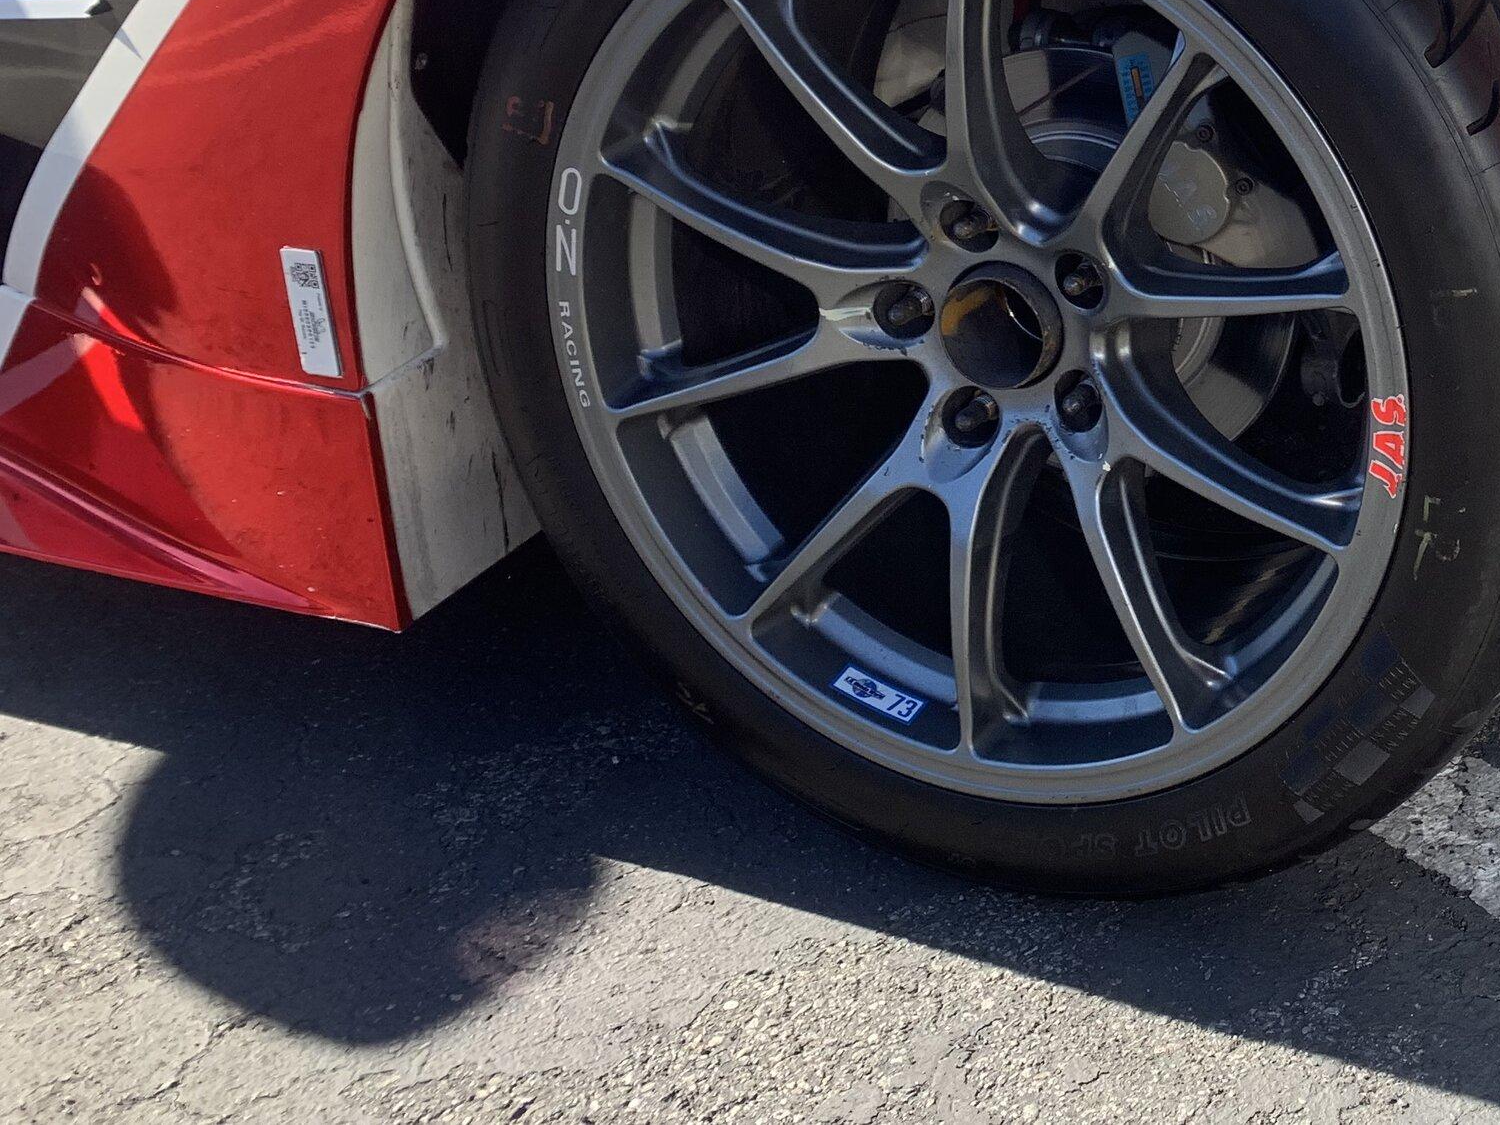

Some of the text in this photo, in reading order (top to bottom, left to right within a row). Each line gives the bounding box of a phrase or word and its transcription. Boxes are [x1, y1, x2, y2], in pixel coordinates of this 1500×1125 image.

[558, 300, 591, 408] RACING
[1369, 394, 1407, 499] JAS
[886, 693, 918, 718] 73
